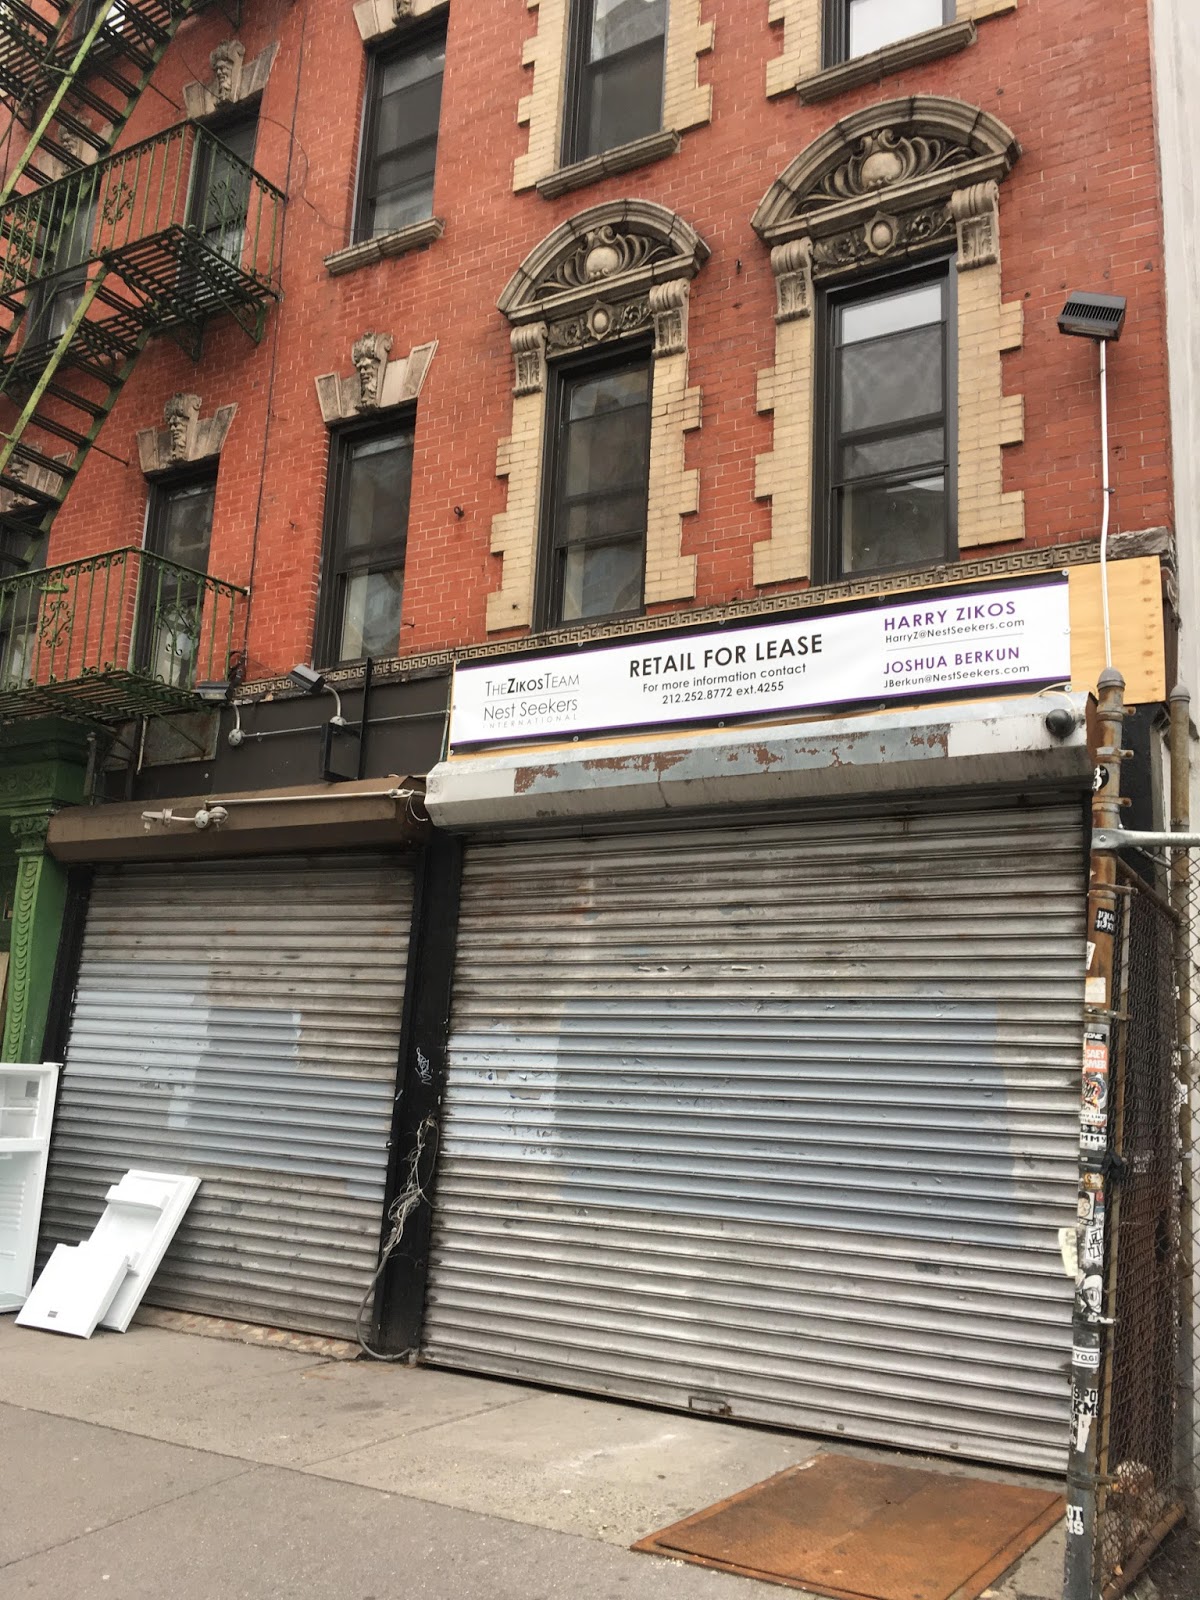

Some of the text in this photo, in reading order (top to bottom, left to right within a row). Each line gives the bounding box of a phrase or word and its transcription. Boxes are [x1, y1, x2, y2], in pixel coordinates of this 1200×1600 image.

[884, 601, 1016, 632] HARRY ZIKOS
[885, 618, 1025, 644] HarryZ@NestSeekers.com
[629, 634, 823, 678] RETAIL FOR LEASE
[883, 647, 1020, 675] JOSHUA BERKUN
[643, 662, 807, 693] For more information contact
[883, 664, 1030, 689] JBerkun@NestSeekers.com
[662, 681, 785, 705] 212.252.8772 ext.4255
[483, 698, 578, 721] Nest Seekers
